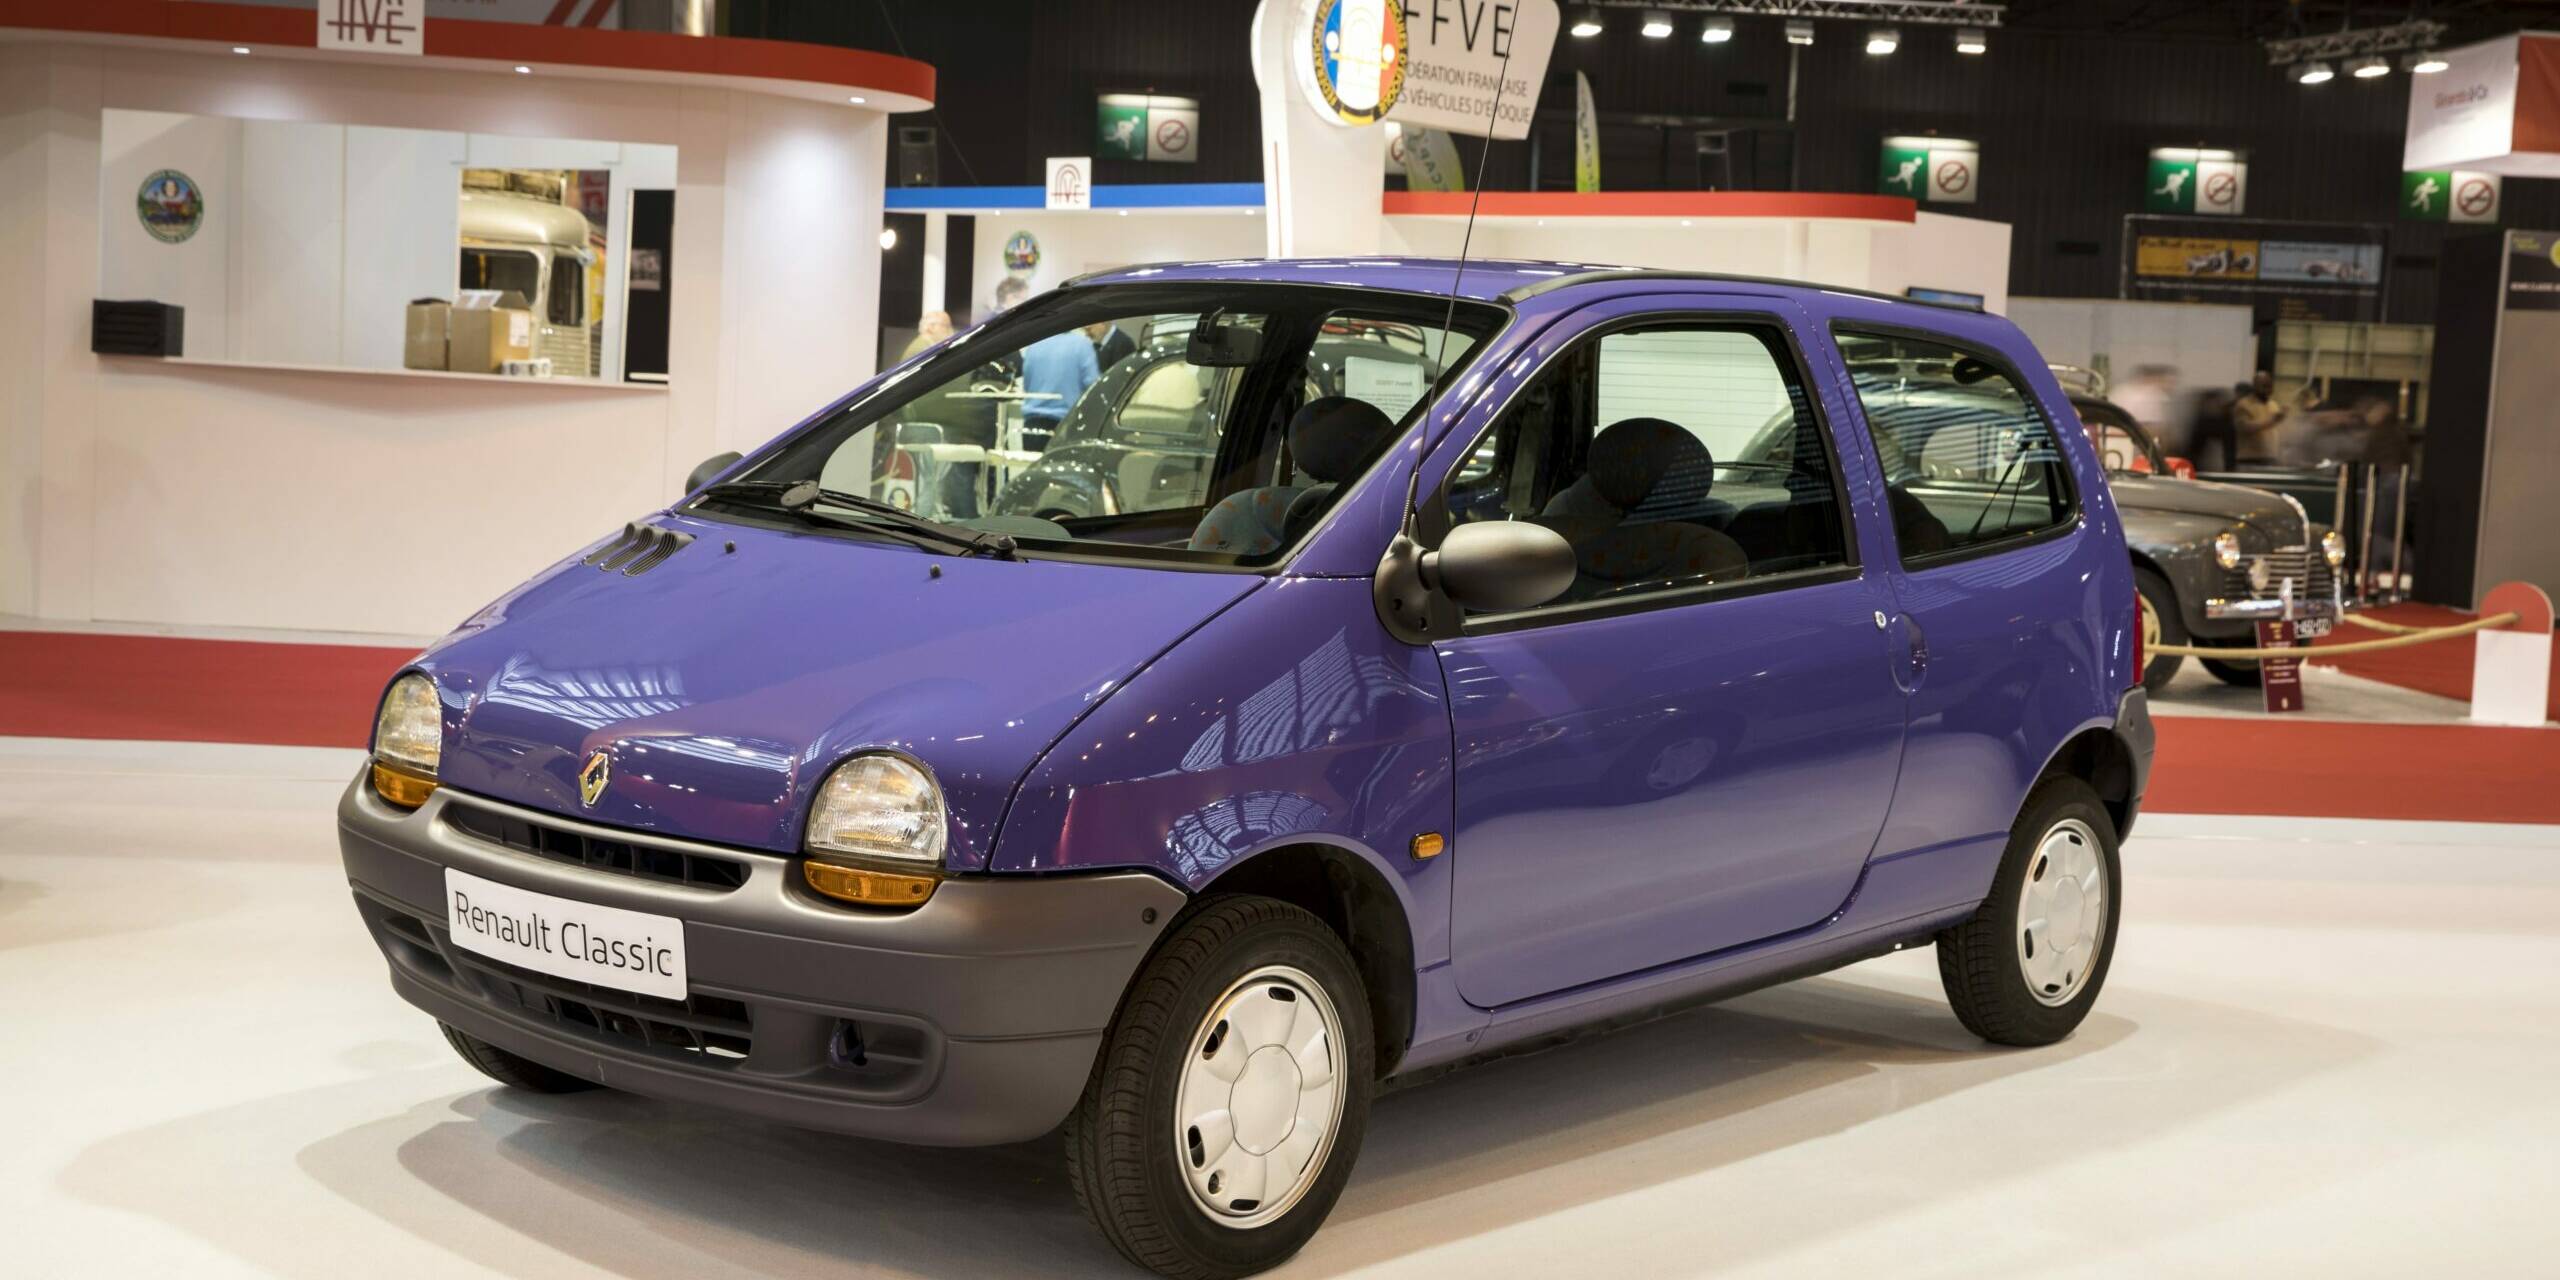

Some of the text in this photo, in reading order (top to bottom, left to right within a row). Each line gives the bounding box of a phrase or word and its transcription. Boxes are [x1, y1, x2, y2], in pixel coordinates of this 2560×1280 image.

[1404, 60, 1465, 86] DÉRATION
[1409, 87, 1471, 114] VÉHICULES
[455, 890, 673, 977] Renault Classic
